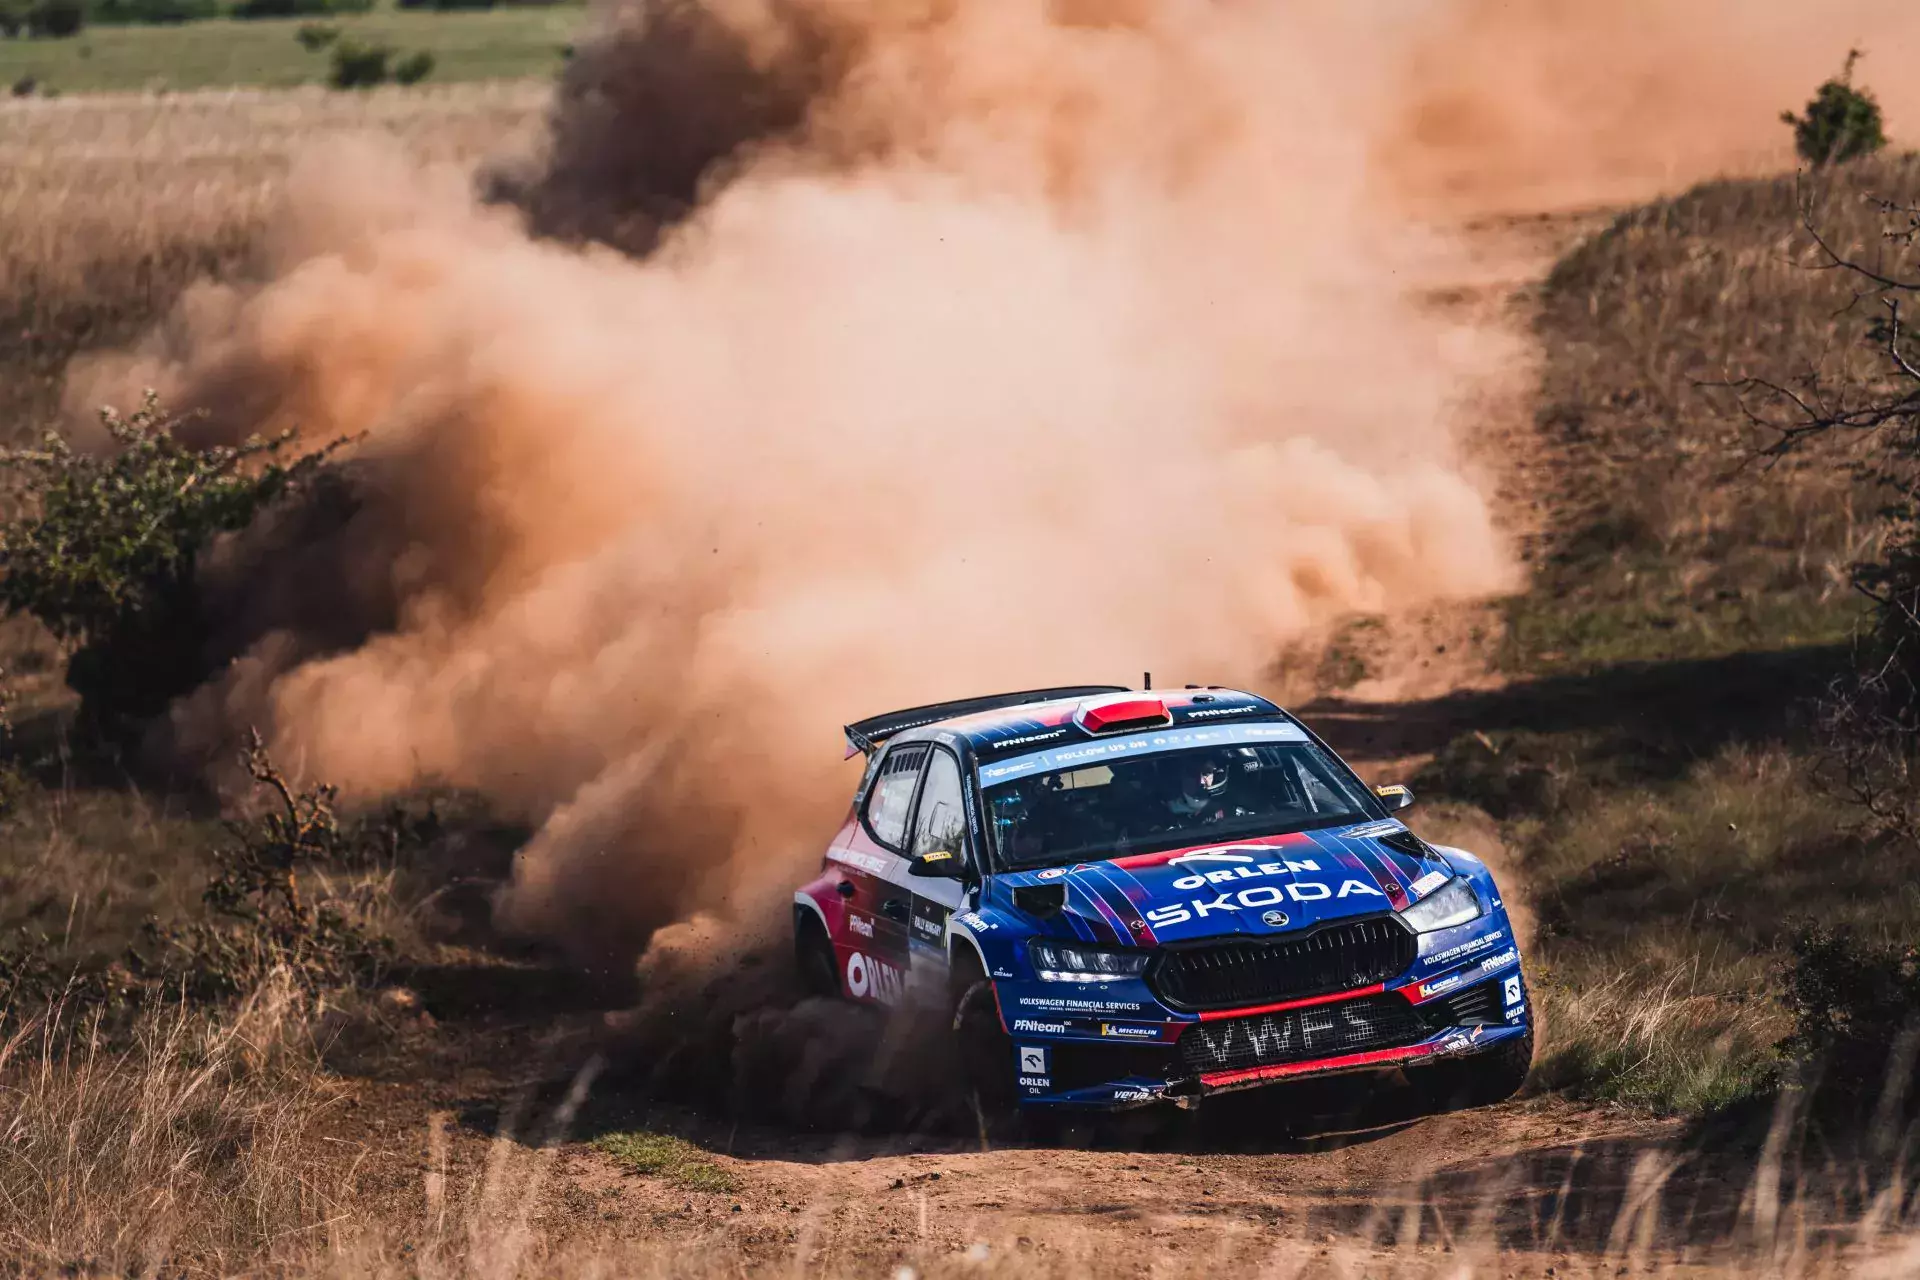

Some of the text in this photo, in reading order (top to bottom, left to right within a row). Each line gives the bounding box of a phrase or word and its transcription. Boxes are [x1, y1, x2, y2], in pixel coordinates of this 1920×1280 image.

[1055, 740, 1148, 761] FOLLOW US ON
[1172, 859, 1322, 890] ORLEN
[1422, 946, 1461, 965] VOLKSWAGEN
[1460, 937, 1485, 951] FINANCIAL
[1484, 930, 1502, 943] SERVICES
[1019, 998, 1065, 1007] VOLKSWAGEN
[1066, 1000, 1105, 1009] FINANCIAL
[1106, 1001, 1141, 1011] SERVICES
[1505, 1004, 1525, 1020] ORLEN
[1118, 1027, 1158, 1036] MICHELIN
[1199, 1001, 1374, 1062] VWFS
[1019, 1077, 1050, 1087] ORLEN
